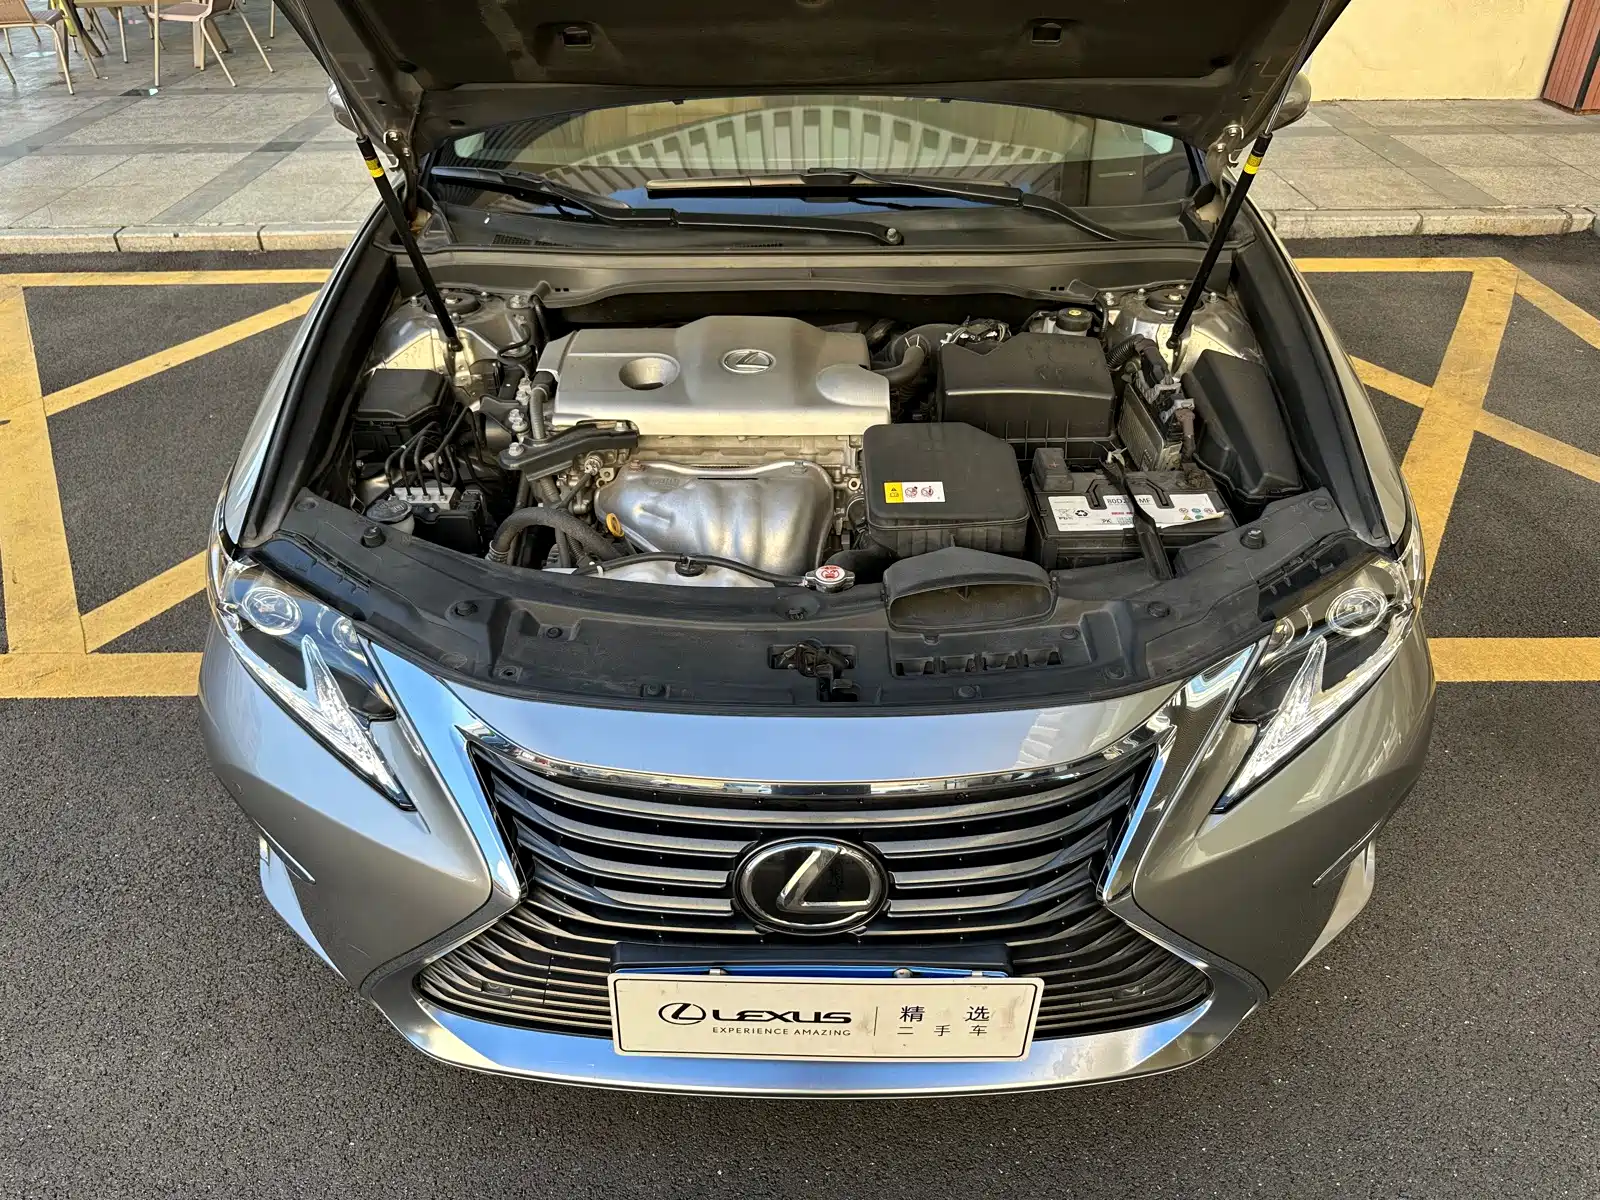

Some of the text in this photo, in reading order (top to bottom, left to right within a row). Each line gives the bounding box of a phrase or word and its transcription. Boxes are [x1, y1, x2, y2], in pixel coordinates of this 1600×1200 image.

[712, 1009, 852, 1024] LEXUS
[712, 1027, 851, 1037] EXPERIENCE AMAZING
